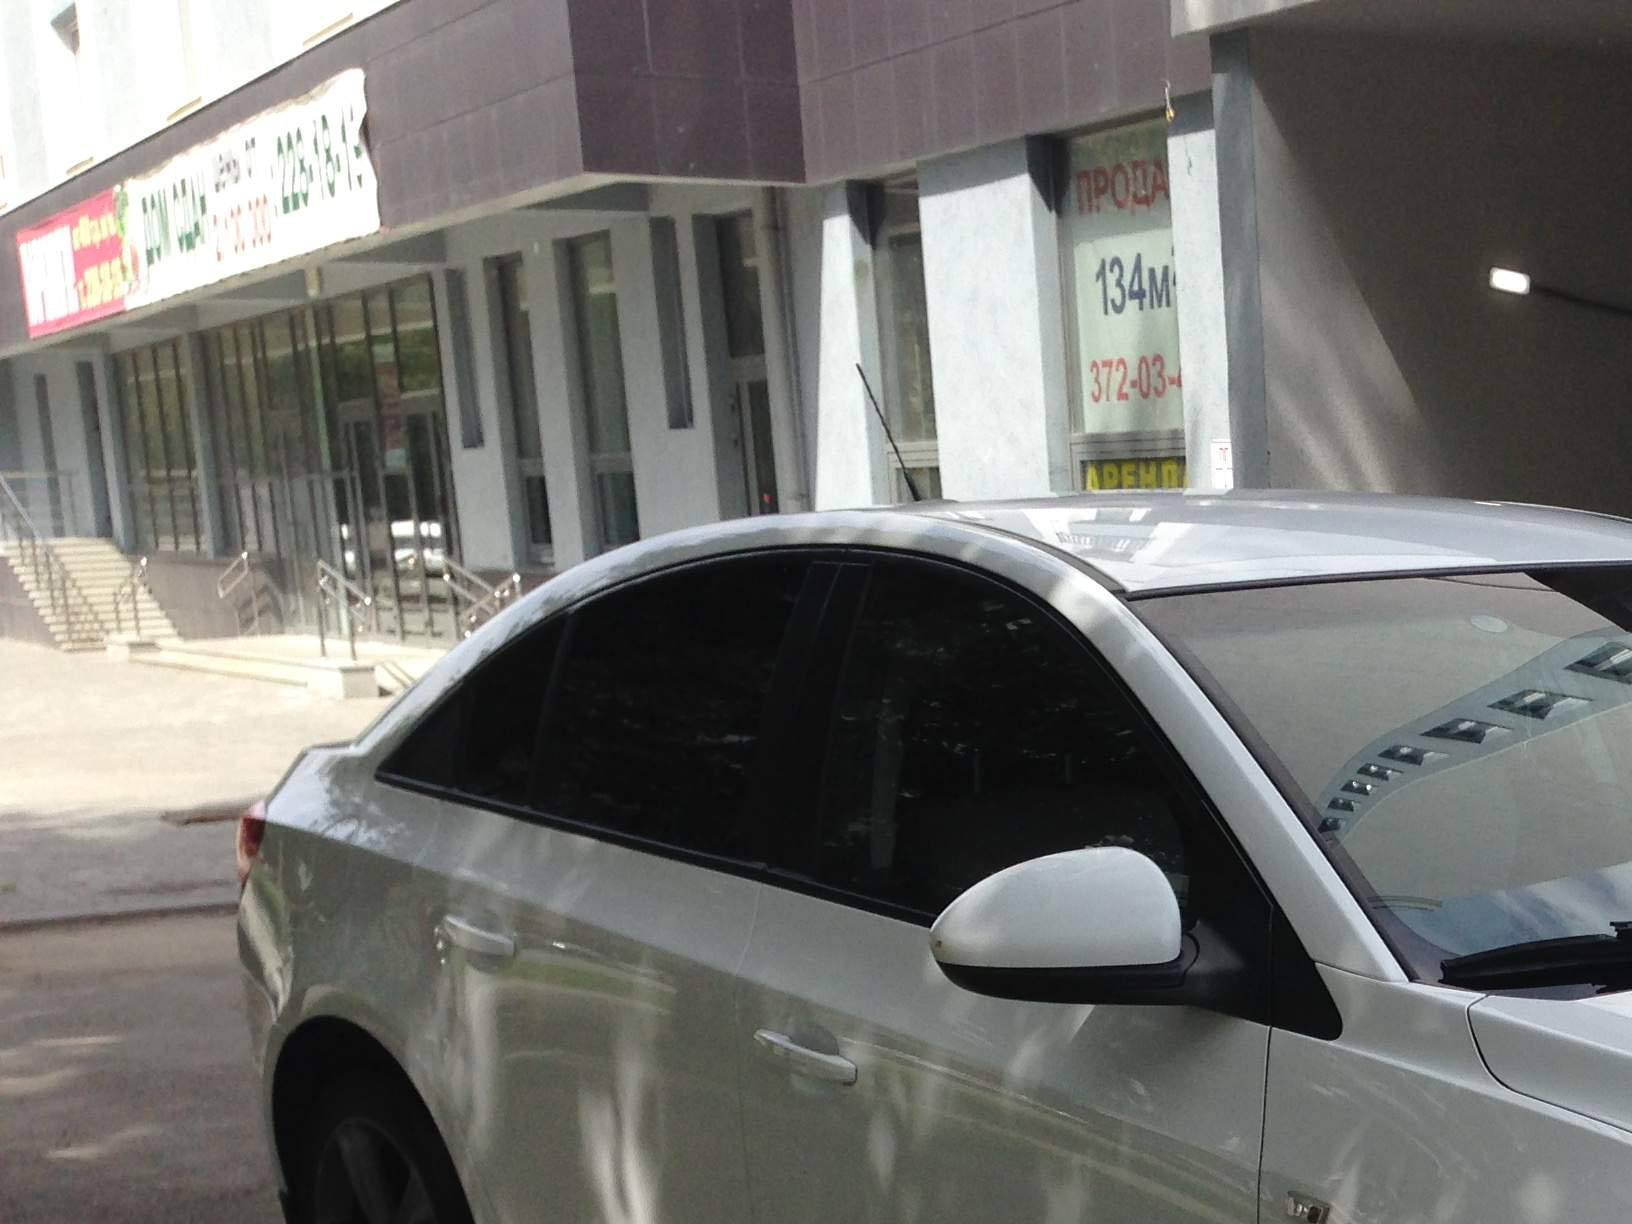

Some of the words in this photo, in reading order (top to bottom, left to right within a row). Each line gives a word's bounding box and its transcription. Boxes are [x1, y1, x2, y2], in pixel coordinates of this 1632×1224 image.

[1095, 246, 1177, 317] 134м
[1089, 353, 1182, 404] 372-03-
[1086, 456, 1188, 492] АРЕНД
